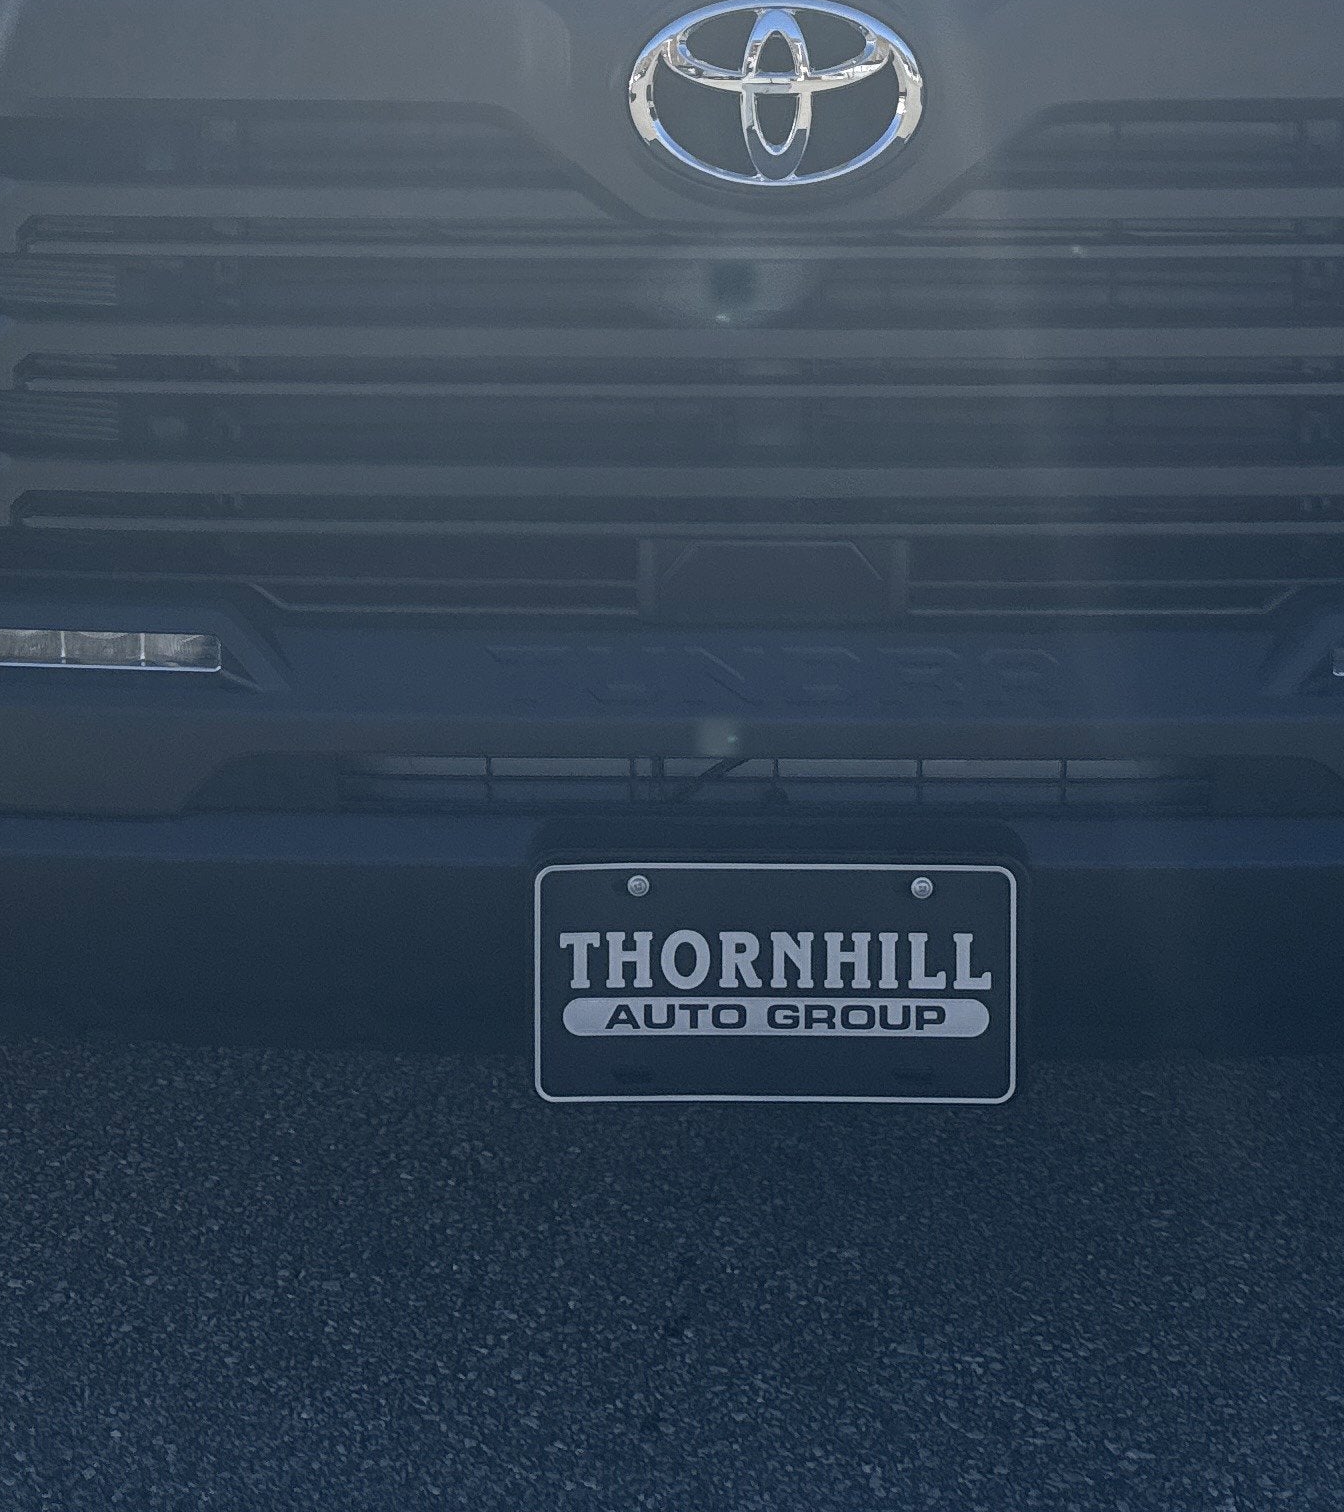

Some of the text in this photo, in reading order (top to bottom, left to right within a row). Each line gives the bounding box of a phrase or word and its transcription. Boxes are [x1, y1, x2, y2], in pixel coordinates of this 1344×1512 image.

[486, 645, 1066, 705] TUNDRA
[559, 929, 992, 990] THORNHILL
[604, 1003, 947, 1031] AUTO GROUP
